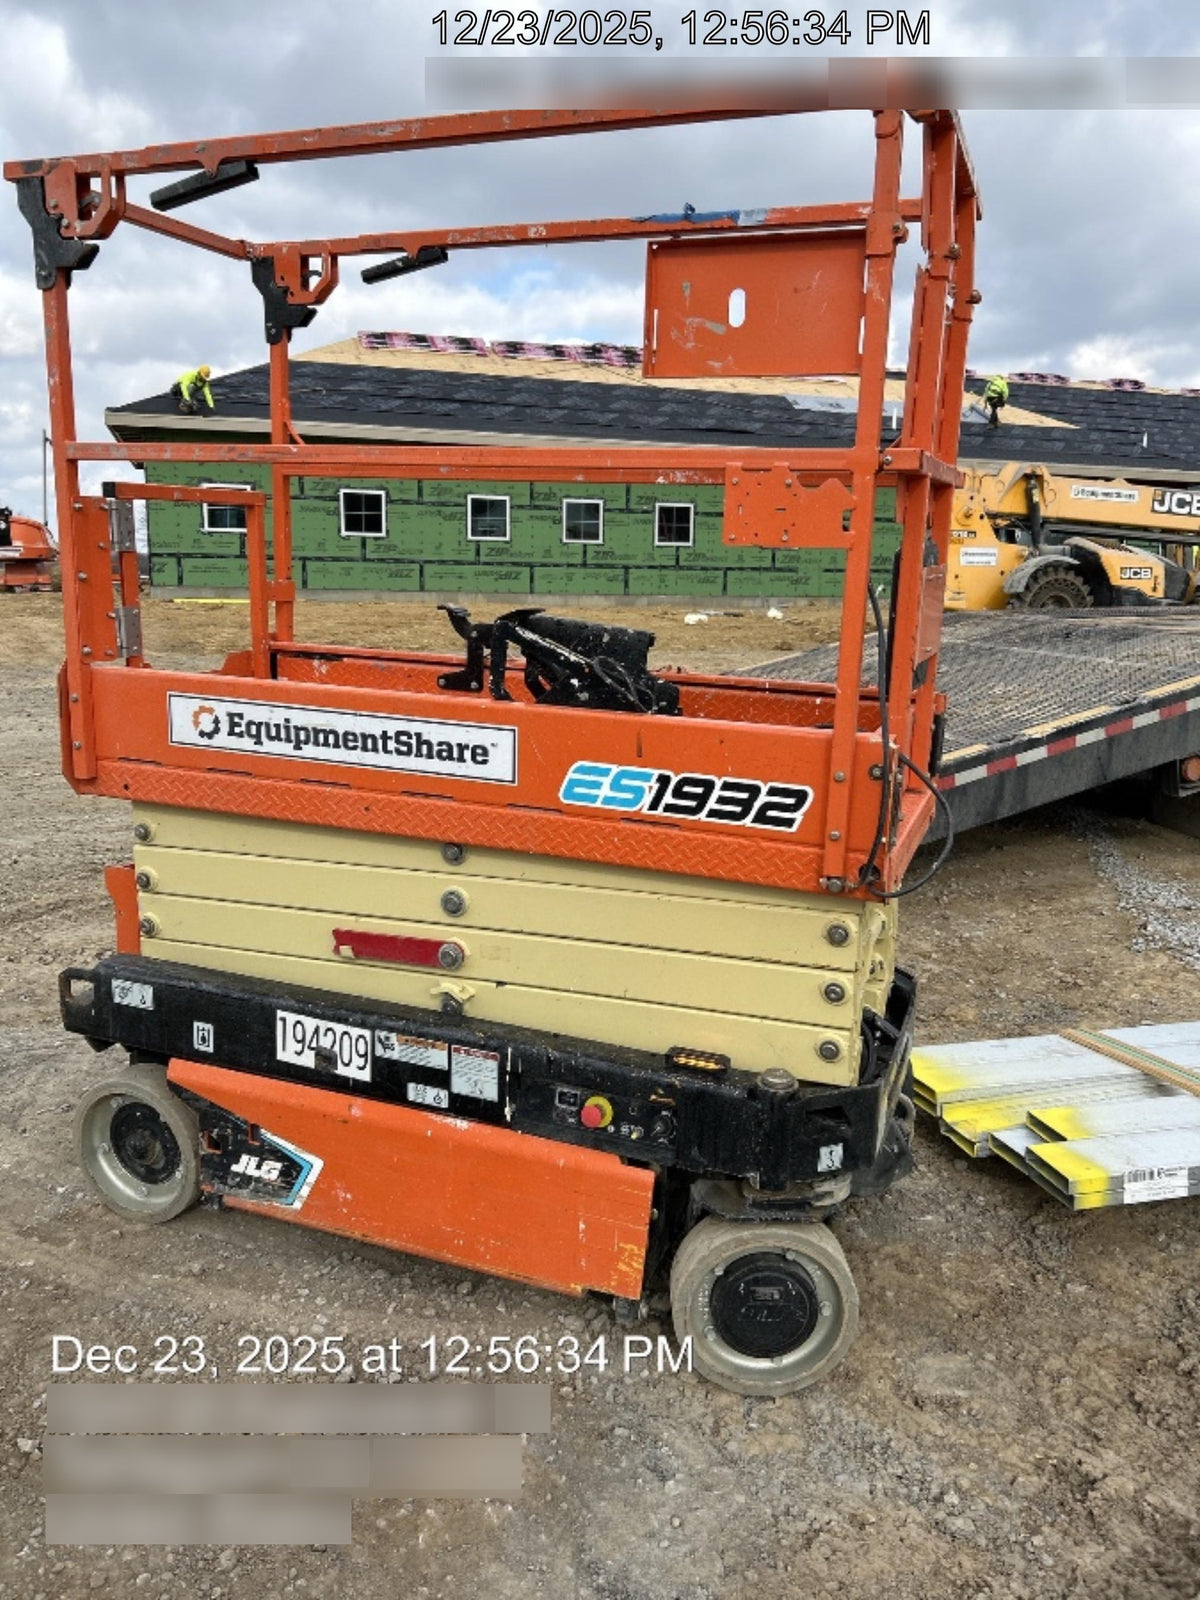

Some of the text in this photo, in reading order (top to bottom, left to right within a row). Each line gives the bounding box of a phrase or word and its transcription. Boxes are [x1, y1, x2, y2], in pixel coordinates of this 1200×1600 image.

[1121, 568, 1151, 579] JCB
[226, 711, 490, 766] EquipmentShare
[558, 761, 814, 832] ES1932
[230, 1153, 283, 1180] JLG
